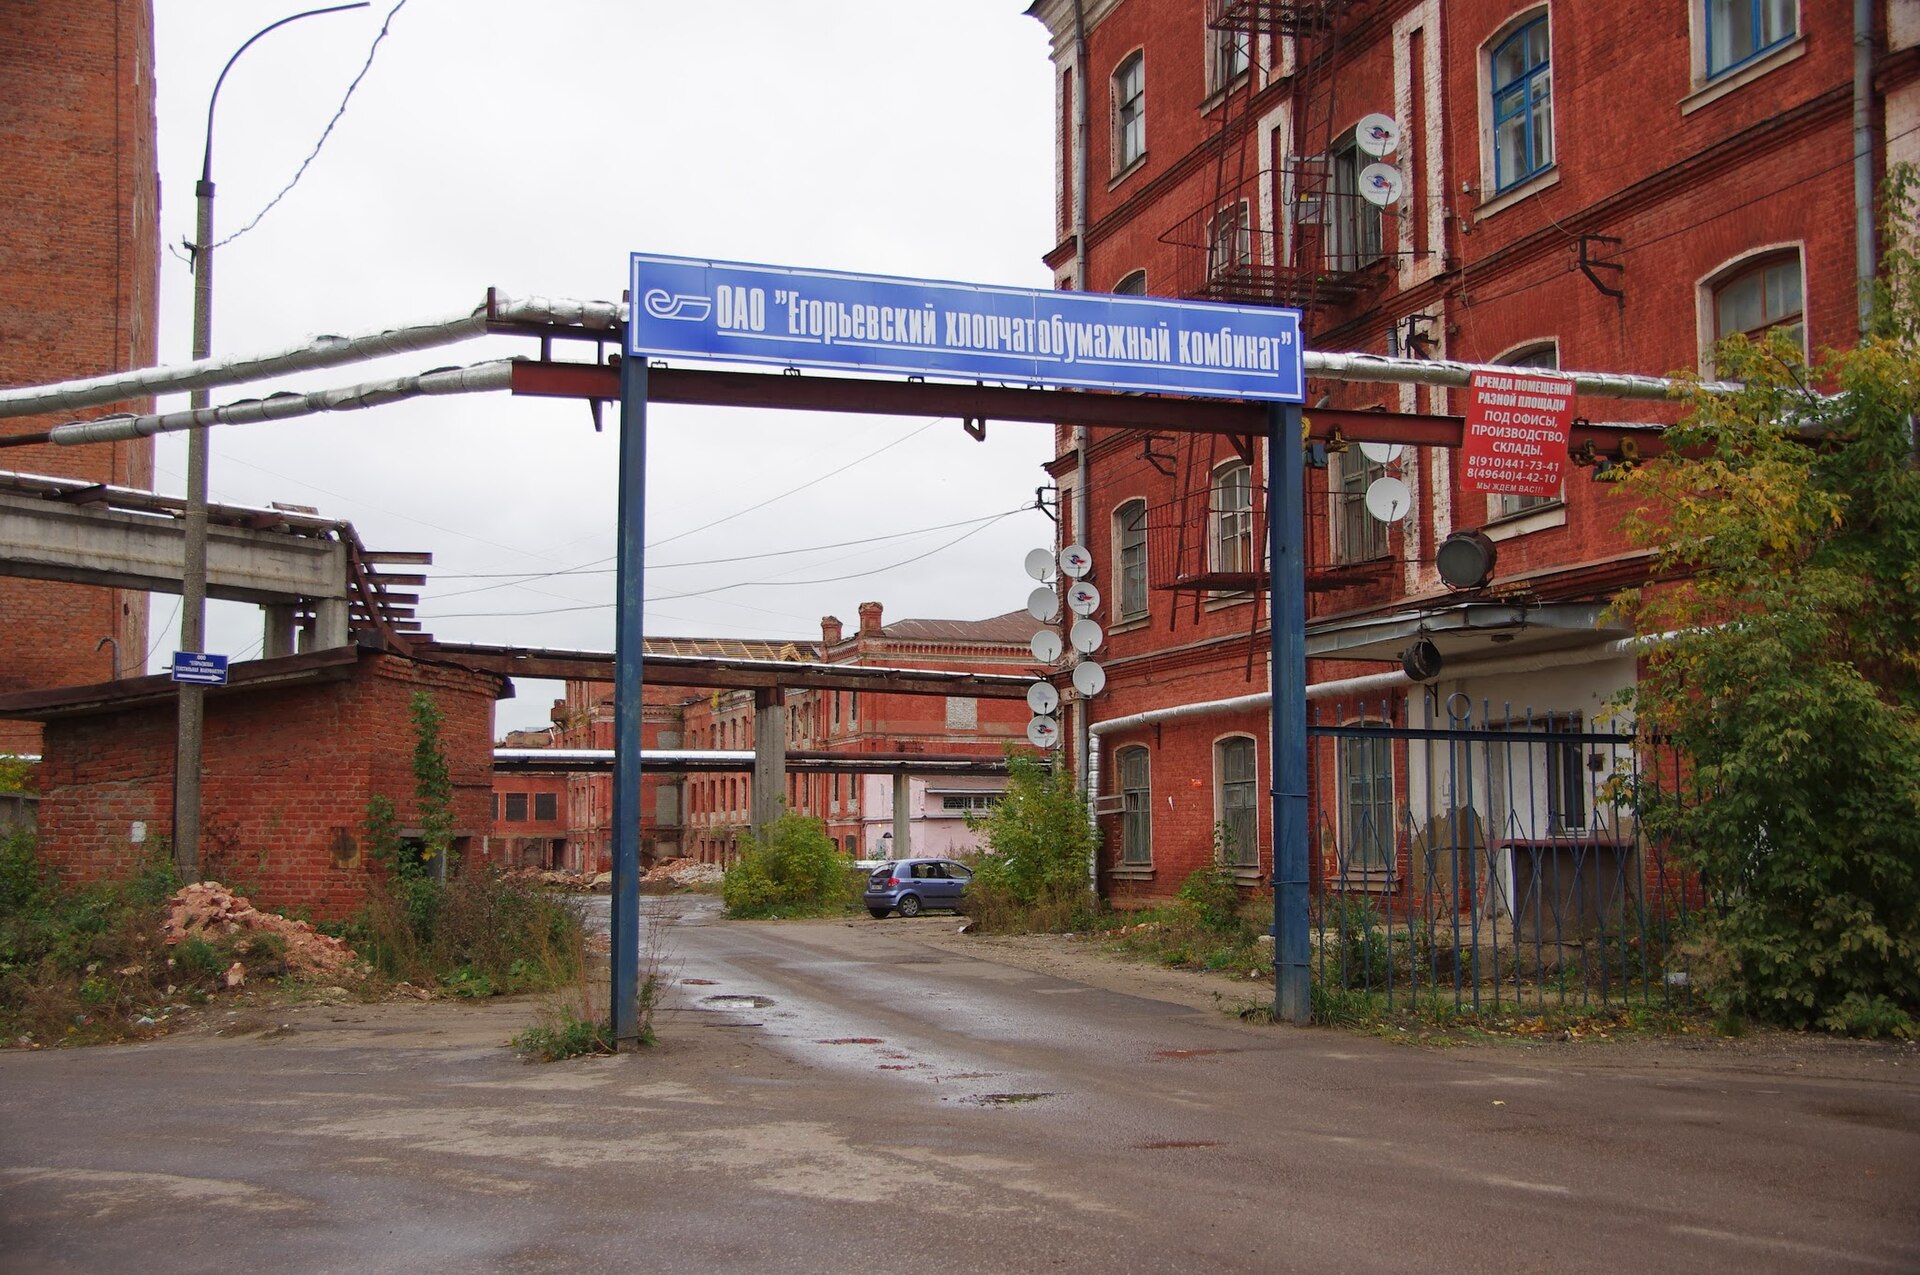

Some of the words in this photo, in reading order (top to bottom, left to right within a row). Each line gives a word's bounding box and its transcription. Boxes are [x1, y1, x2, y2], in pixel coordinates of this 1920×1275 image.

[717, 285, 766, 332] ОАО
[945, 311, 1171, 364] хлопчатобумажный
[1474, 375, 1513, 391] АРЕНДА
[1514, 379, 1573, 396] ПОМЕЩЕНИЙ
[1477, 392, 1516, 407] РАЗНОЙ
[1518, 395, 1566, 412] ПЛОЩАДИ
[1485, 410, 1510, 425] ПОД
[1512, 413, 1558, 428] ОФИСЫ,
[1471, 424, 1566, 444] ПРОИЗВОДСТВО,
[1492, 441, 1543, 457] СКЛАДЫ.
[1468, 456, 1559, 472] 8(910)441-73-41
[1466, 468, 1557, 484] 8(49640)4-42-10
[1476, 482, 1491, 490] МЫ
[1492, 483, 1517, 492] ЖДЕМ
[1518, 484, 1544, 493] ВАС!!!
